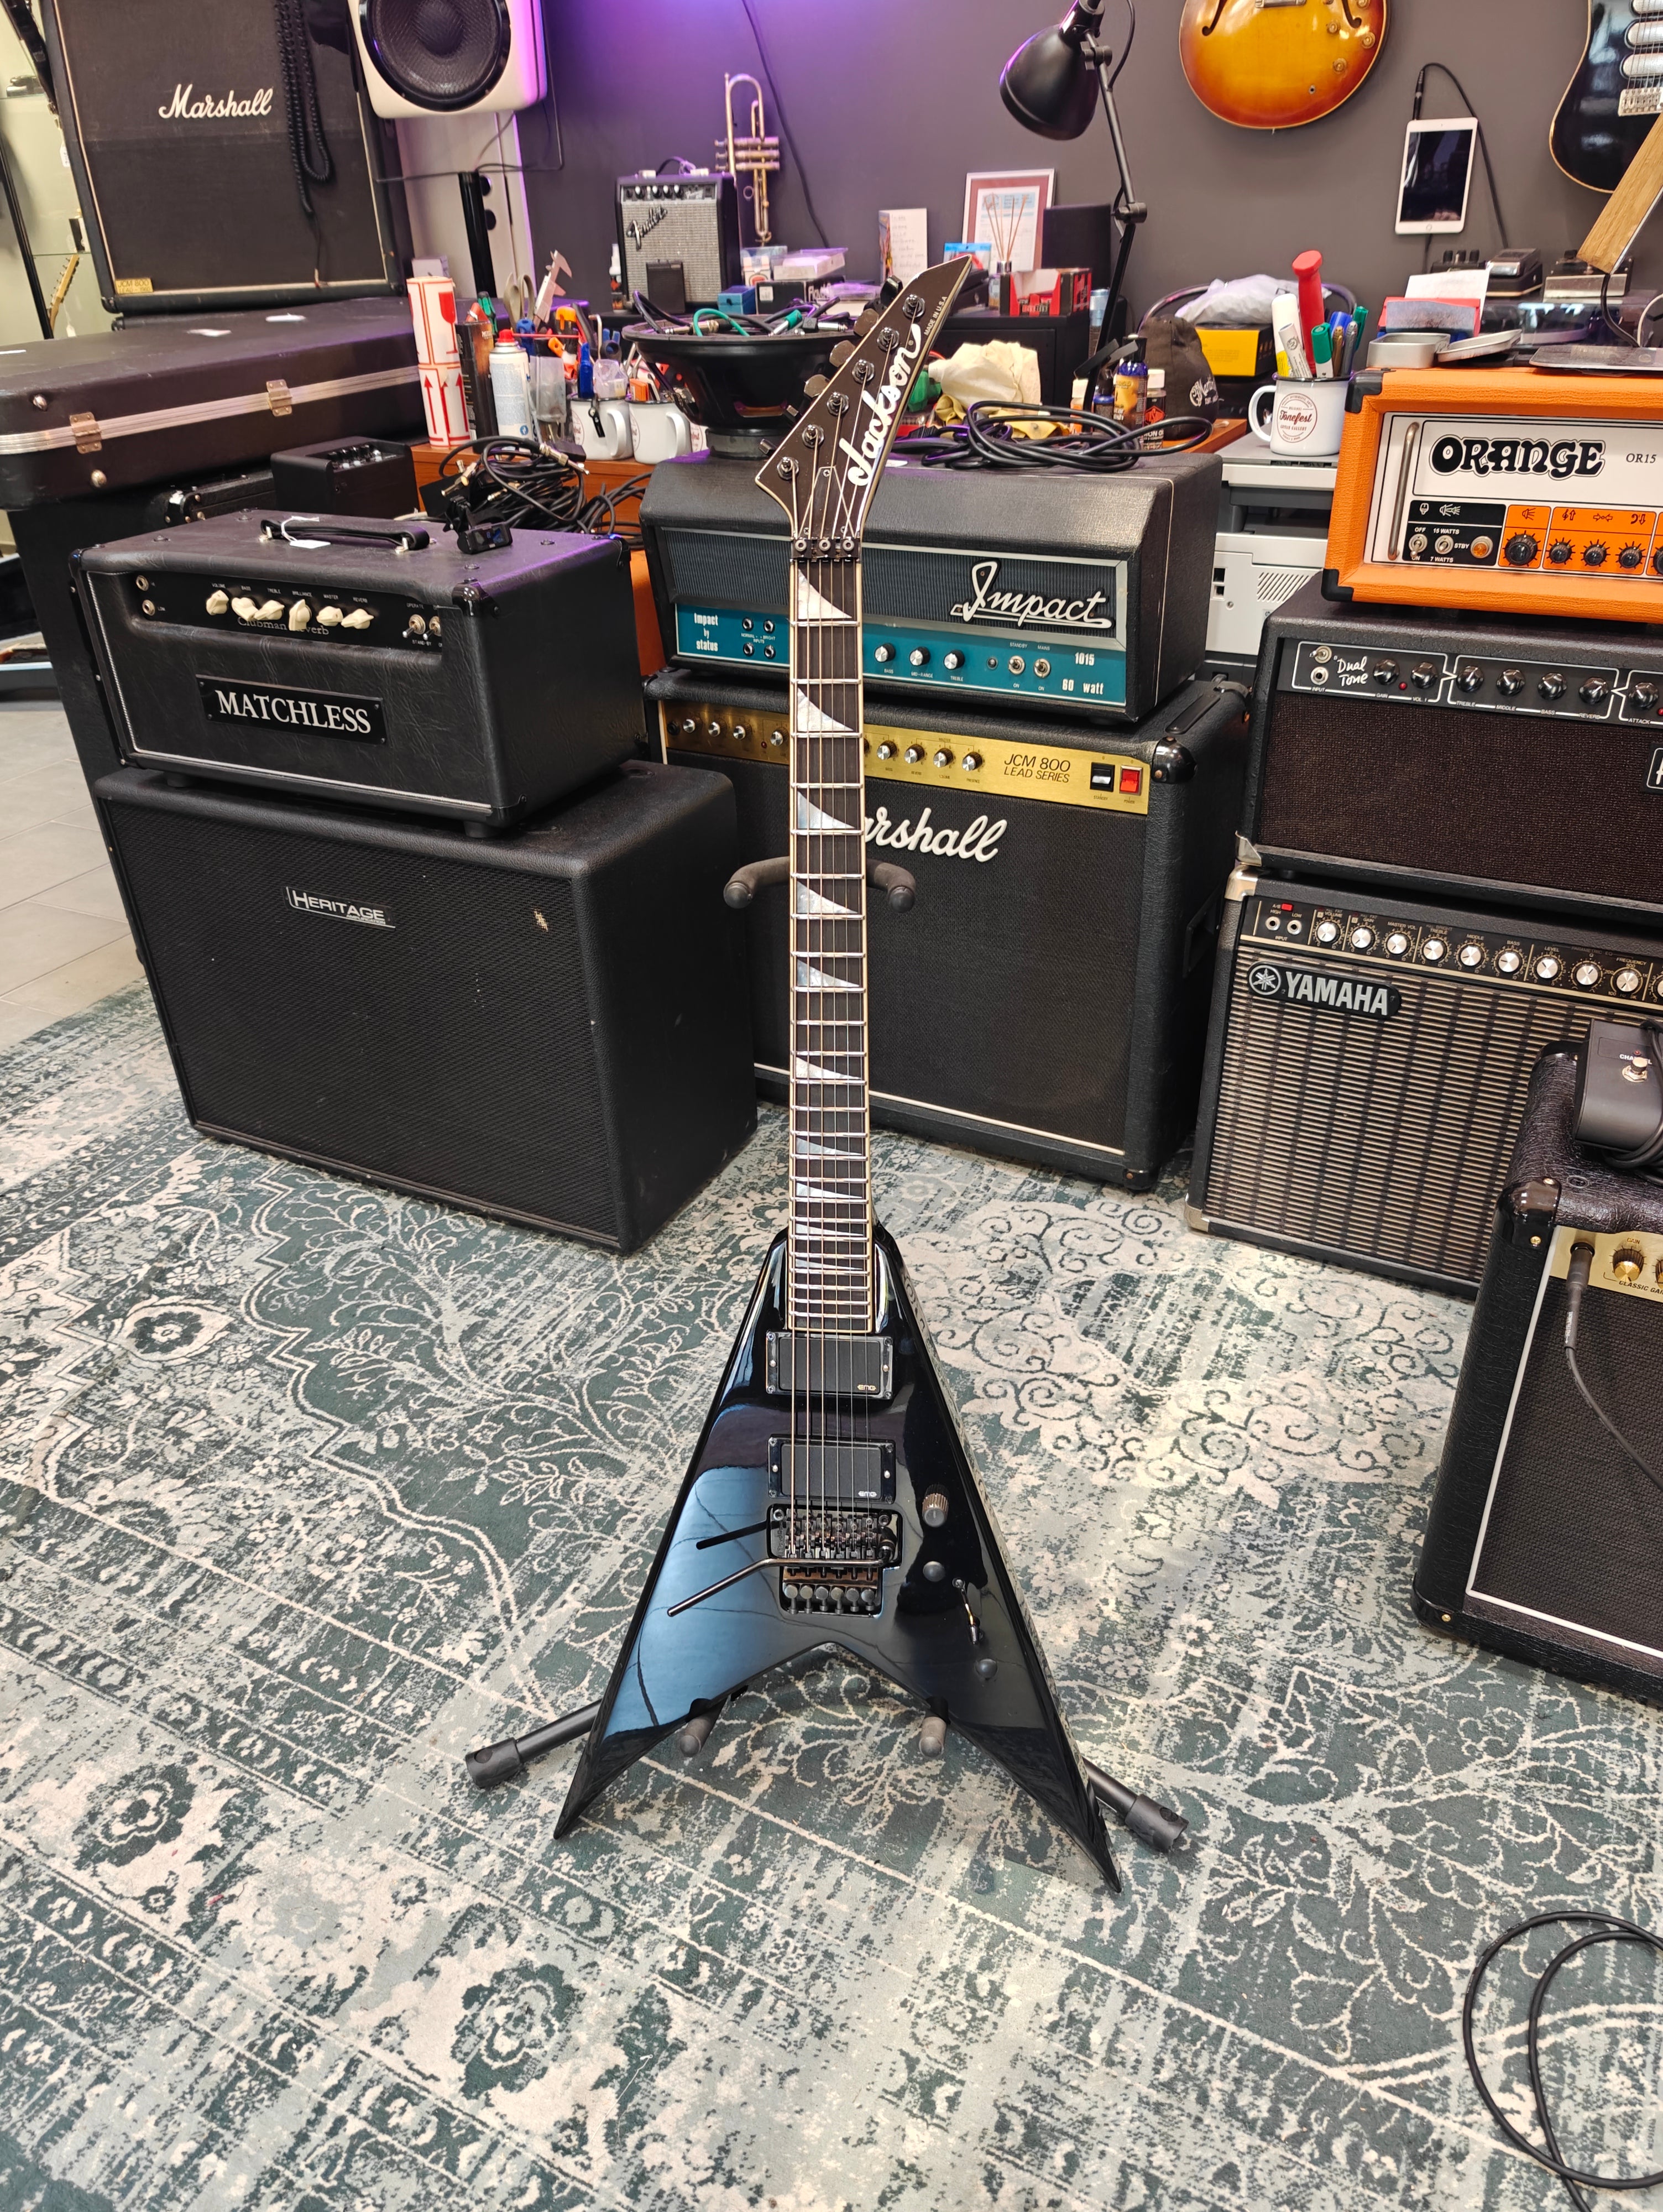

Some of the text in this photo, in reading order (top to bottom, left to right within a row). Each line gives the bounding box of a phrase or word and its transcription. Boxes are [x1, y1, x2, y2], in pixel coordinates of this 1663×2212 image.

[158, 84, 274, 119] Marshall
[923, 319, 935, 336] MADE
[839, 324, 921, 486] Jackson
[1279, 410, 1312, 425] Tonefest
[1431, 436, 1605, 479] ORANGE
[1626, 453, 1656, 463] OR15
[950, 561, 1112, 628] Impact
[694, 613, 718, 627] Impact
[703, 628, 710, 639] by
[696, 639, 718, 651] status
[1075, 652, 1095, 666] 1015
[1337, 656, 1367, 674] Dual
[1062, 679, 1104, 695] 60 watt
[1338, 672, 1368, 687] Tone
[215, 690, 371, 733] MATCHLESS
[1004, 754, 1071, 773] JCM 800
[1003, 766, 1070, 783] LEAD SERIES
[865, 807, 1007, 862] rshall
[292, 890, 385, 921] HERITAGE
[346, 914, 386, 925] AMPLIFICATION
[1616, 957, 1647, 966] FREQUENCY
[1285, 971, 1388, 1015] YAMAHA
[1619, 1053, 1652, 1065] CHAL
[1619, 1280, 1649, 1291] CLASSIC
